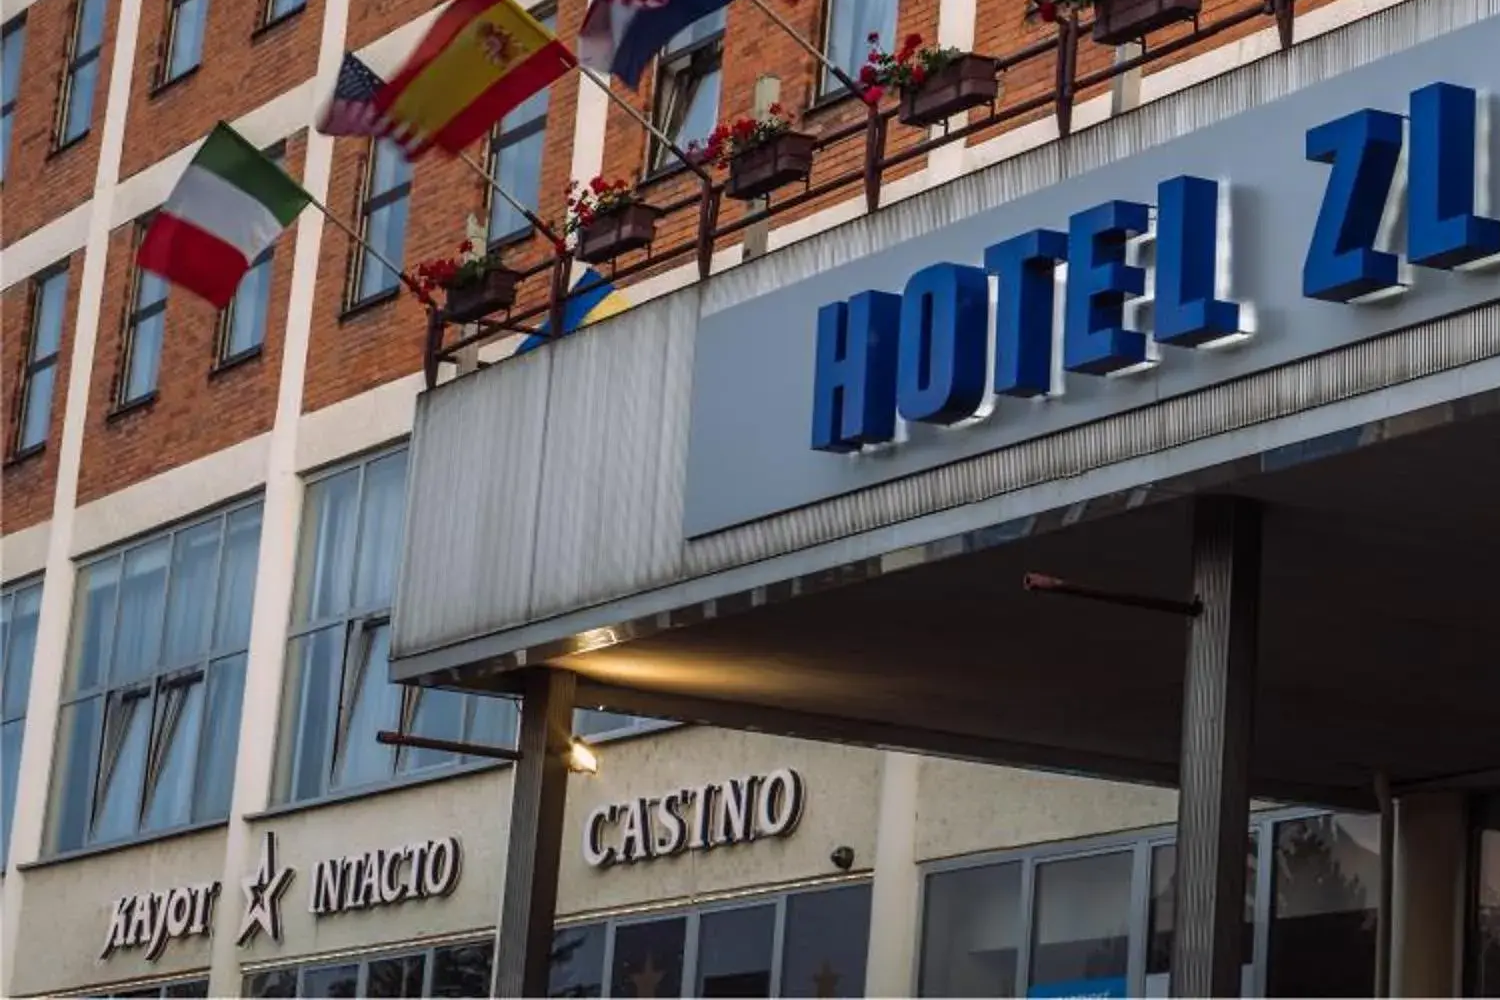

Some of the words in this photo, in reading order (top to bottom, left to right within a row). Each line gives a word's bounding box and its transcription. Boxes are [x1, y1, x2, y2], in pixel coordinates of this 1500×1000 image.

[811, 175, 1247, 453] HOTEL
[99, 880, 222, 962] KAJOT
[308, 836, 462, 917] INTACTO
[583, 767, 805, 867] CASINO
